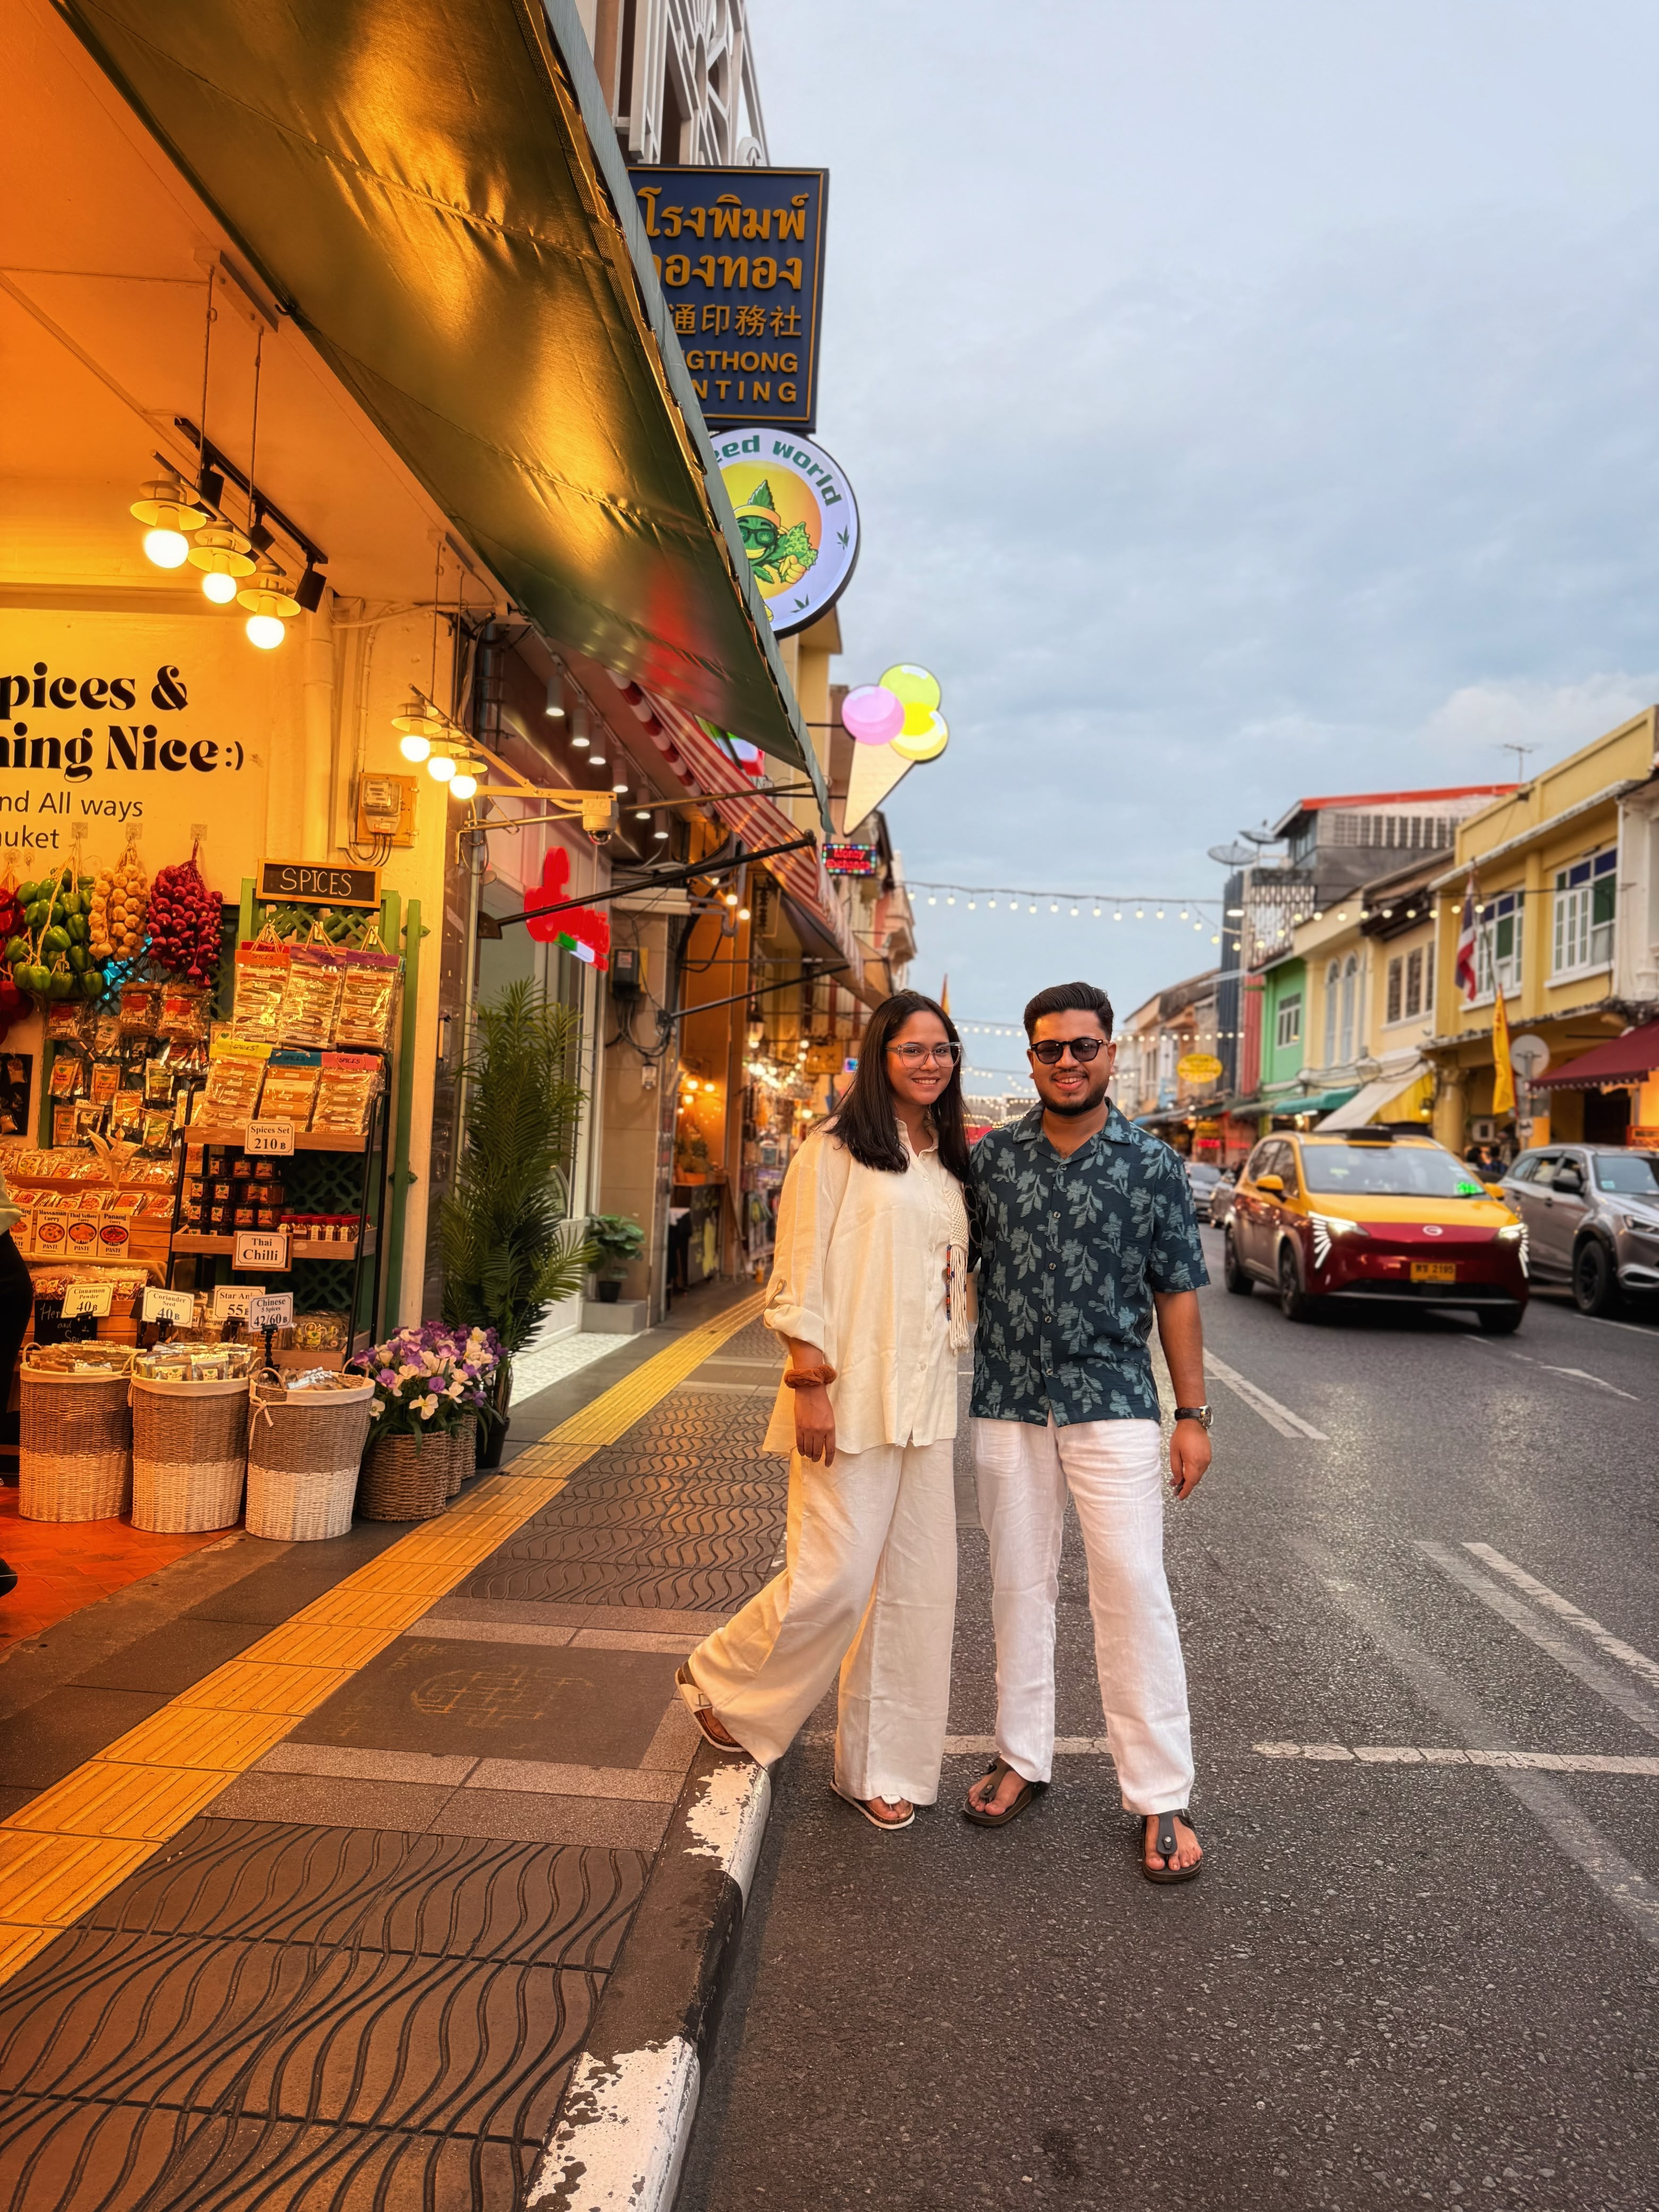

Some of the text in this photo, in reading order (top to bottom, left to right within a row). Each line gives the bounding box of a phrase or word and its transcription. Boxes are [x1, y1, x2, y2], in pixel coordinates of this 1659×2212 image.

[637, 186, 809, 241] โรงพิมพ์
[668, 304, 802, 338] 通印務社
[682, 350, 798, 373] GTHONG
[773, 440, 842, 507] world
[151, 665, 188, 711] &
[38, 791, 71, 814] All
[81, 799, 144, 823] ways
[0, 825, 60, 849] uket
[833, 849, 866, 860] Money
[280, 868, 351, 896] SPICES
[251, 1126, 275, 1135] Spices
[254, 1138, 278, 1149] 210
[252, 1237, 272, 1246] Thai
[243, 1249, 278, 1261] Chilli
[153, 1293, 187, 1303] Coriander
[257, 1298, 286, 1307] Chinese
[40, 1303, 60, 1321] Her
